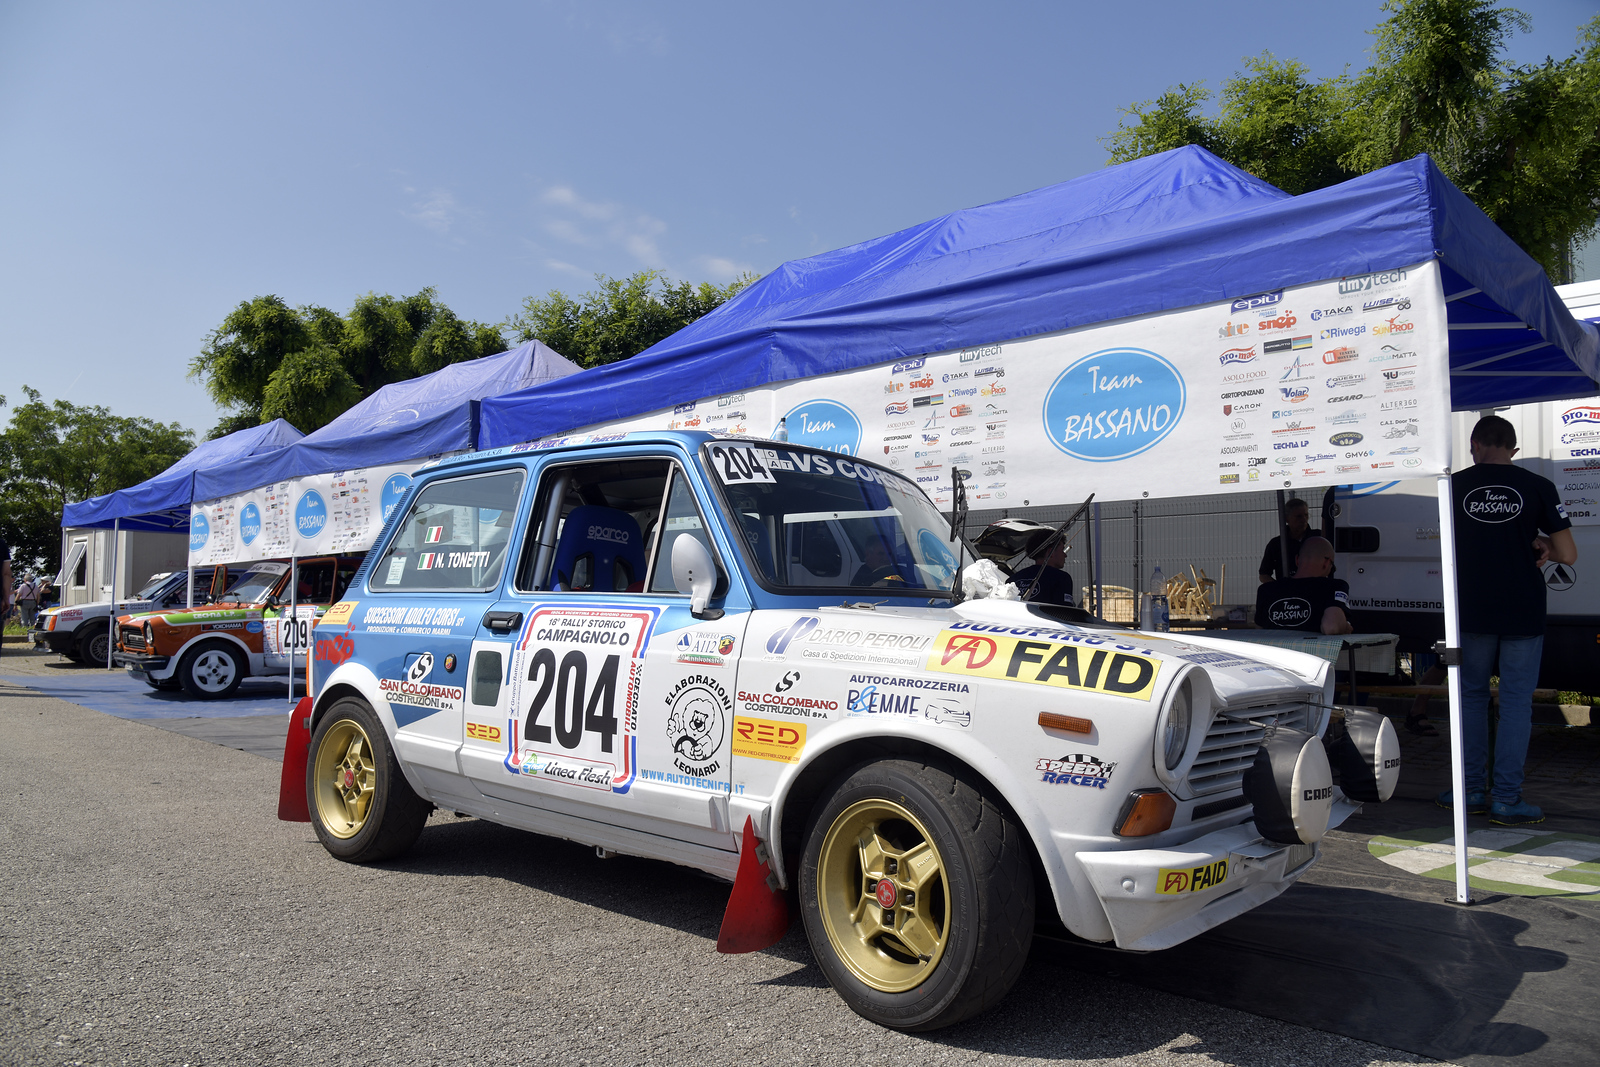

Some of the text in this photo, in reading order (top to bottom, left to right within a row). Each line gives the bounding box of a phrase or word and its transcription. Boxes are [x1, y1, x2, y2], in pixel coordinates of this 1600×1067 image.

[1324, 306, 1353, 315] TAKA
[1331, 325, 1366, 338] Riwega
[1088, 366, 1143, 393] Team
[1222, 373, 1245, 382] ASOLO
[1246, 370, 1267, 379] FOOD
[1234, 403, 1261, 411] CARON
[1327, 394, 1363, 403] CESARO
[800, 413, 836, 435] Team
[1063, 404, 1171, 443] BASSANO
[712, 446, 769, 480] 204
[391, 481, 406, 495] Team
[1485, 490, 1508, 501] Team
[306, 495, 319, 508] Team
[1469, 501, 1520, 514] BASSANO
[299, 515, 326, 529] BASSANO
[588, 525, 629, 541] sparco
[434, 551, 490, 568] N. TONETTI
[1272, 609, 1309, 621] BASSANO
[1283, 602, 1300, 611] Team
[363, 607, 406, 624] SUCCESSORI
[403, 607, 434, 625] ADOLFO
[431, 608, 460, 626] CORSI
[561, 618, 586, 627] RALLY
[587, 620, 626, 629] STORICO
[537, 629, 630, 646] CAMPAGNOLO
[809, 630, 931, 650] DARIO PERIOLI
[692, 640, 717, 654] A112
[802, 649, 918, 666] Casa di Spedizioni Internazionali
[1005, 641, 1154, 694] FAID
[379, 678, 462, 700] SAN COLOMBANO
[849, 674, 970, 693] AUTOCARROZZERIA
[385, 692, 439, 708] COSTRUZIONI
[524, 648, 620, 753] 204
[624, 660, 637, 733] AUTOMOBILI
[665, 674, 733, 711] ELABORAZIONI
[737, 691, 839, 711] SAN COLOMBANO
[630, 677, 641, 731] CECCATO
[744, 702, 811, 717] COSTRUZIONI
[467, 722, 500, 739] RED
[737, 721, 800, 745] RED
[544, 761, 611, 786] Linea Flesh
[673, 757, 721, 778] LEONARDI
[1036, 758, 1102, 776] SPEED
[1042, 771, 1109, 789] RACER
[1190, 861, 1227, 892] FAID
